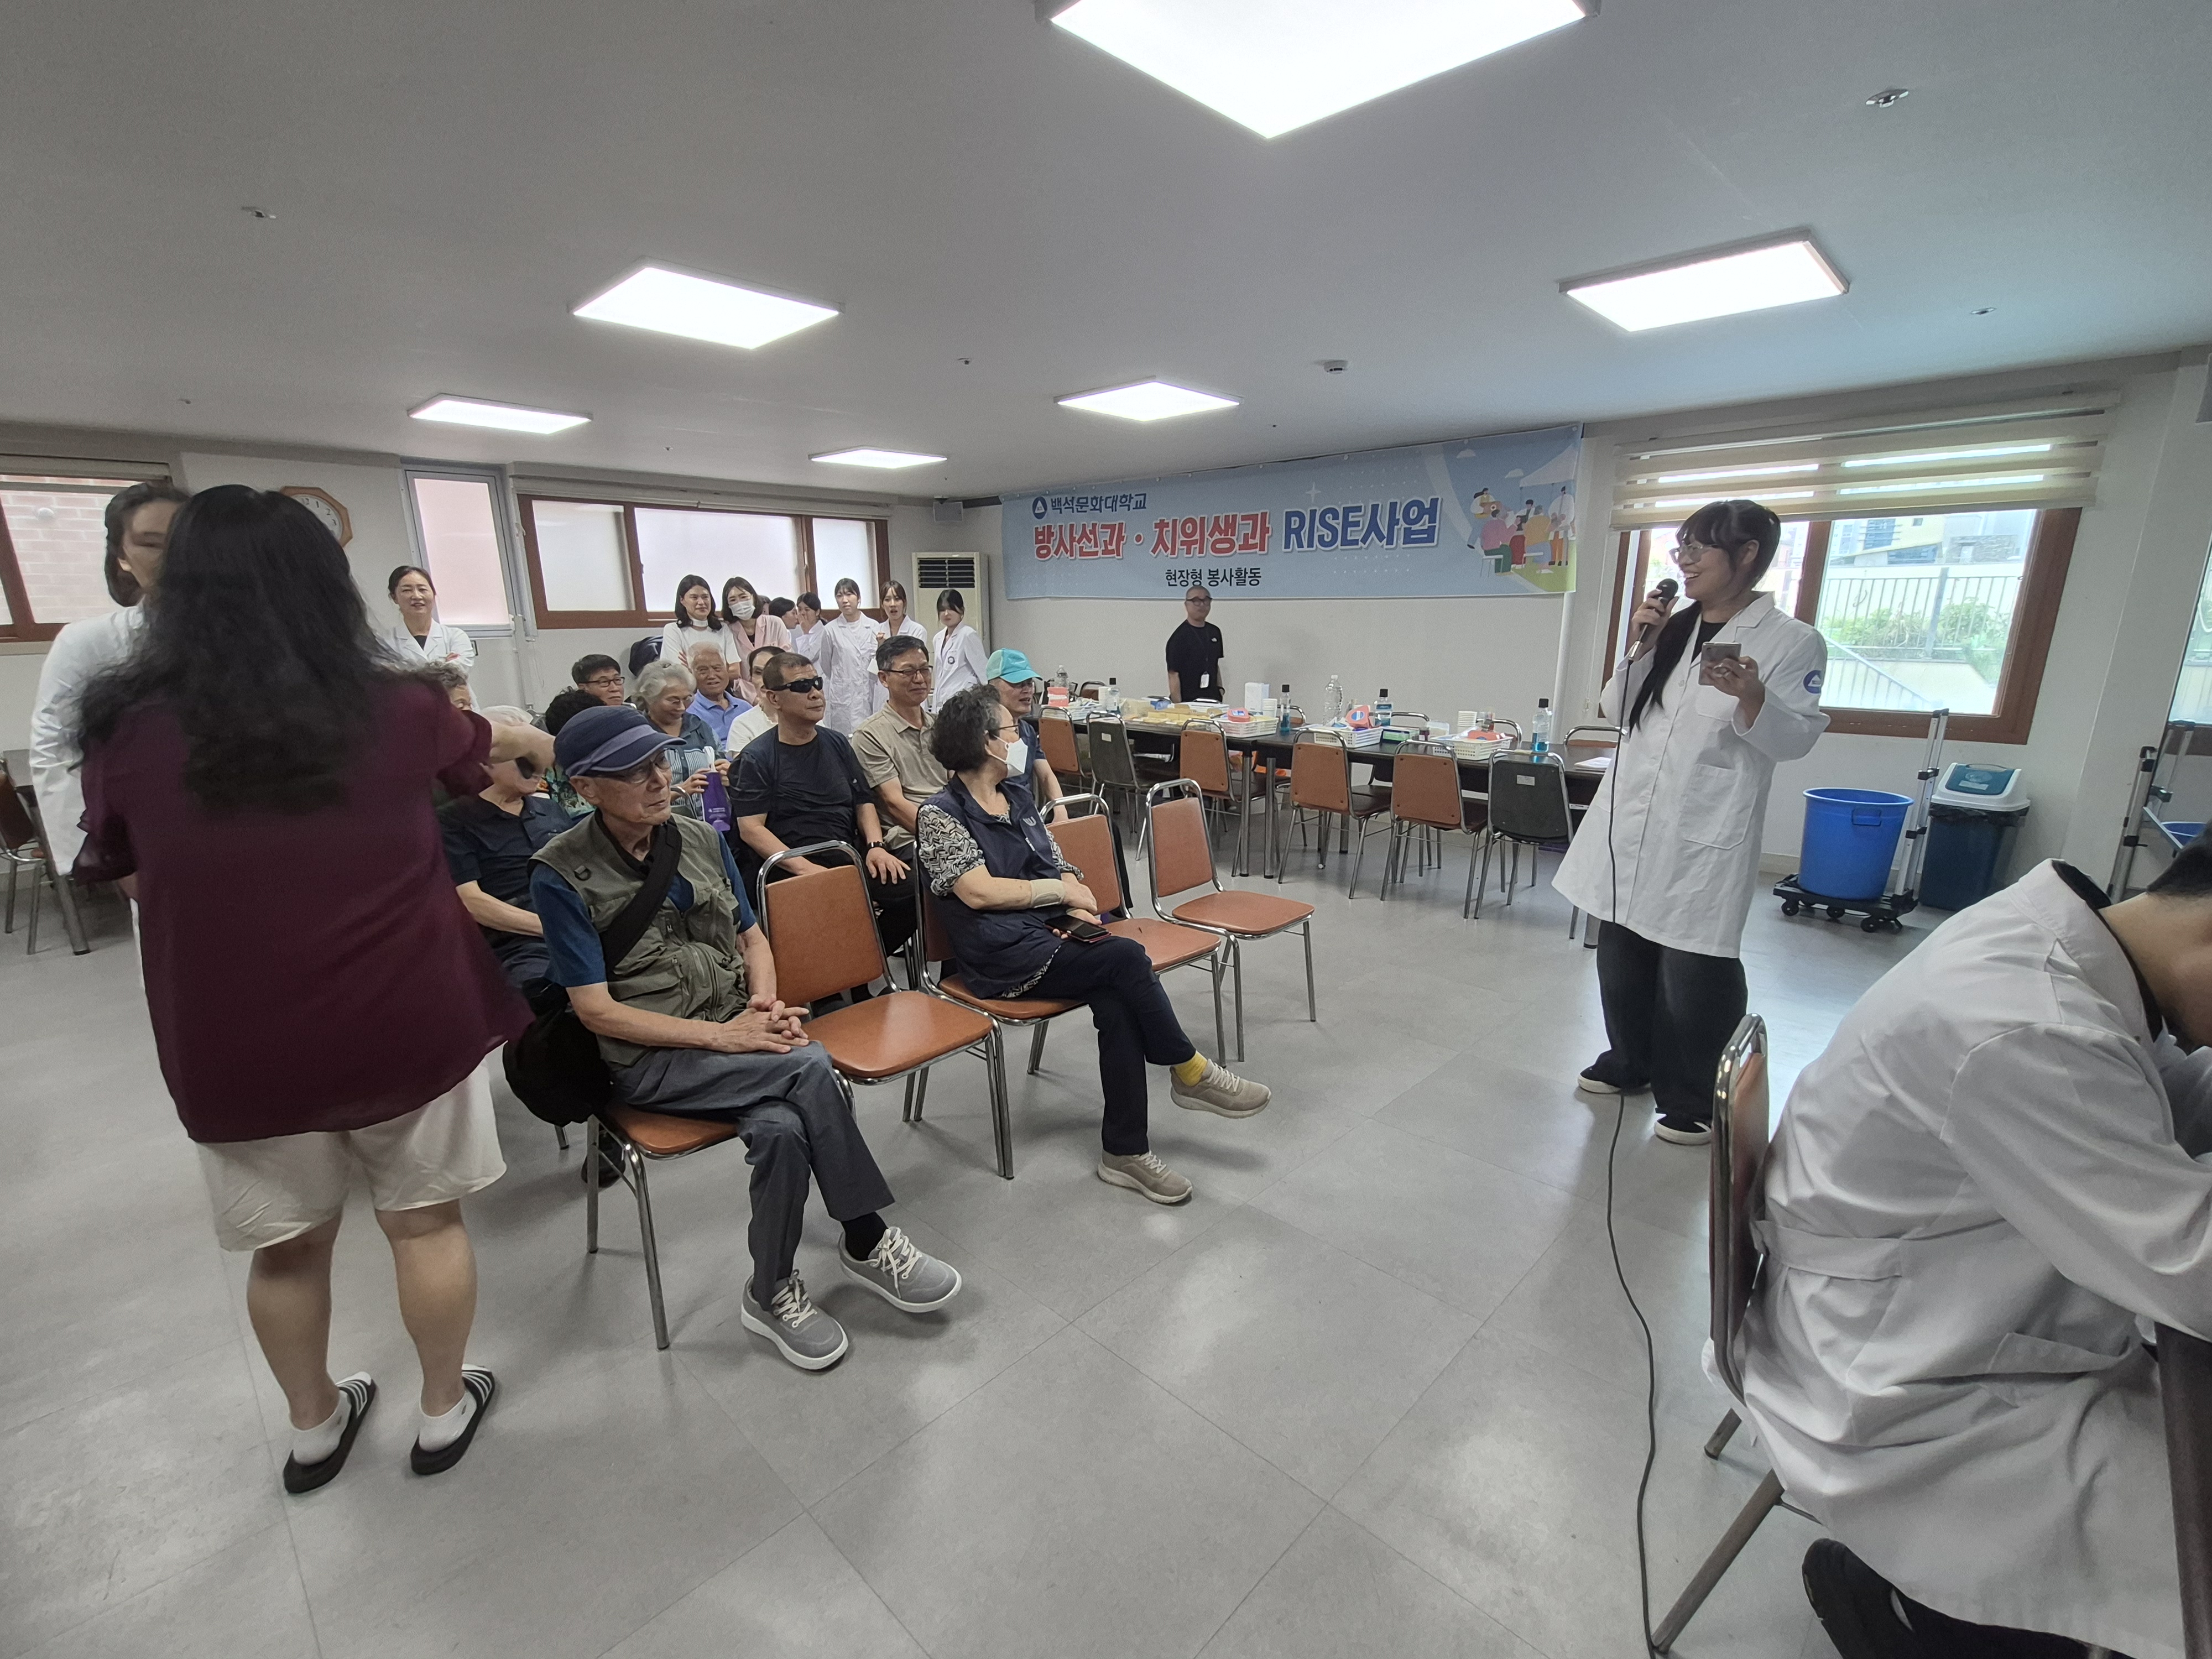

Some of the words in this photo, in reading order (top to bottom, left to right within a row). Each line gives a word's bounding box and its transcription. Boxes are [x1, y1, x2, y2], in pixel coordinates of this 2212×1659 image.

[1051, 493, 1147, 514] 백석문화대학교
[1034, 522, 1126, 560] 방사선과
[1150, 511, 1270, 556] 치위생과
[1283, 497, 1440, 550] RISE사업
[1165, 568, 1203, 587] 현장형
[1207, 567, 1262, 587] 봉사활동
